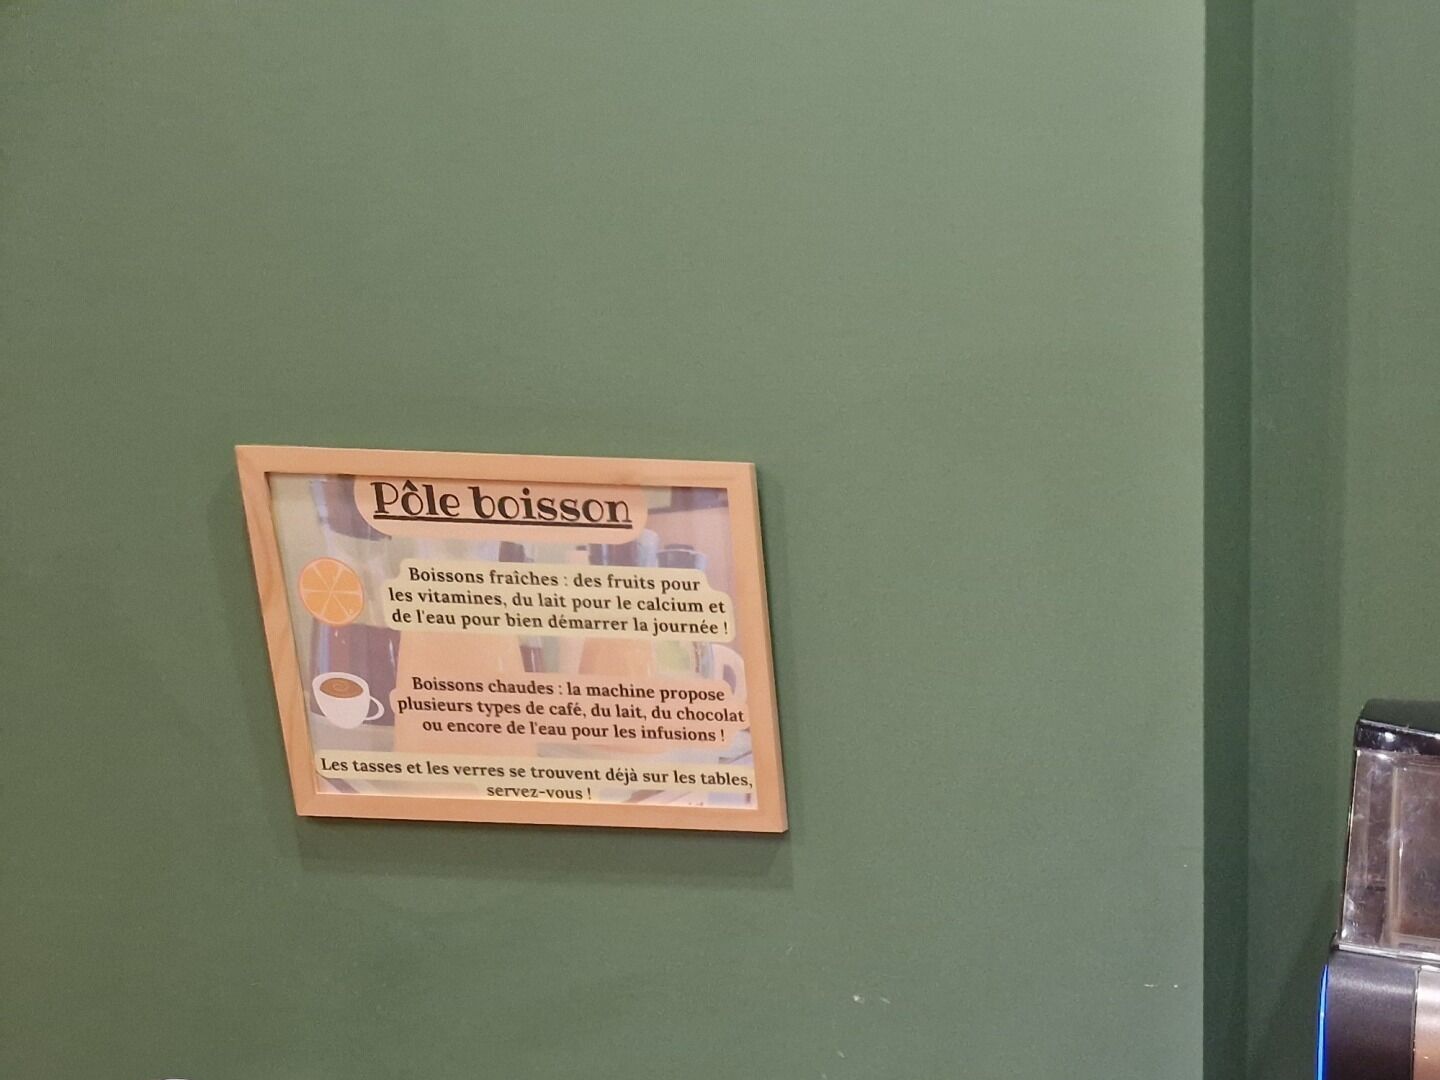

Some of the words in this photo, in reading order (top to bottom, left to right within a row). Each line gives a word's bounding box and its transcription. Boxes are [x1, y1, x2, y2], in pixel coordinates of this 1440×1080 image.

[371, 479, 460, 517] Pôle
[467, 486, 632, 523] boisson
[408, 567, 484, 584] Boissons
[489, 569, 559, 586] fraîches
[573, 573, 602, 588] des
[607, 574, 655, 590] fruits
[661, 579, 701, 594] pour
[389, 587, 413, 602] les
[418, 589, 507, 608] vitamines,
[511, 592, 533, 607] du
[539, 593, 567, 608] lait
[572, 597, 611, 613] pour
[617, 596, 632, 610] le
[637, 597, 703, 613] calcium
[709, 601, 726, 614] et
[391, 609, 412, 624] de
[416, 610, 455, 625] l'eau
[462, 614, 501, 629] pour
[505, 612, 543, 628] bien
[549, 614, 628, 632] démarrer
[634, 617, 648, 632] la
[652, 619, 719, 637] journée
[412, 676, 484, 693] Boissons
[488, 679, 554, 695] chaudes
[567, 682, 581, 696] la
[586, 683, 655, 699] machine
[660, 688, 725, 704] propose
[398, 696, 473, 715] plusieurs
[477, 700, 521, 717] types
[526, 700, 544, 715] de
[549, 701, 587, 719] café,
[591, 703, 611, 718] du
[615, 704, 647, 720] lait,
[651, 706, 672, 720] du
[676, 707, 745, 723] chocolat
[422, 720, 442, 732] ou
[447, 721, 501, 734] encore
[506, 721, 525, 734] de
[530, 721, 567, 736] l'eau
[571, 726, 609, 740] pour
[613, 724, 637, 739] les
[641, 725, 716, 741] infusions
[320, 758, 348, 771] Les
[352, 759, 402, 774] tasses
[406, 761, 422, 774] et
[427, 761, 449, 775] les
[453, 765, 504, 777] verres
[509, 767, 527, 778] se
[531, 766, 601, 780] trouvent
[605, 767, 638, 785] déjà
[643, 771, 669, 783] sur
[673, 770, 696, 785] les
[701, 771, 753, 788] tables,
[487, 785, 583, 799] servez-vous
